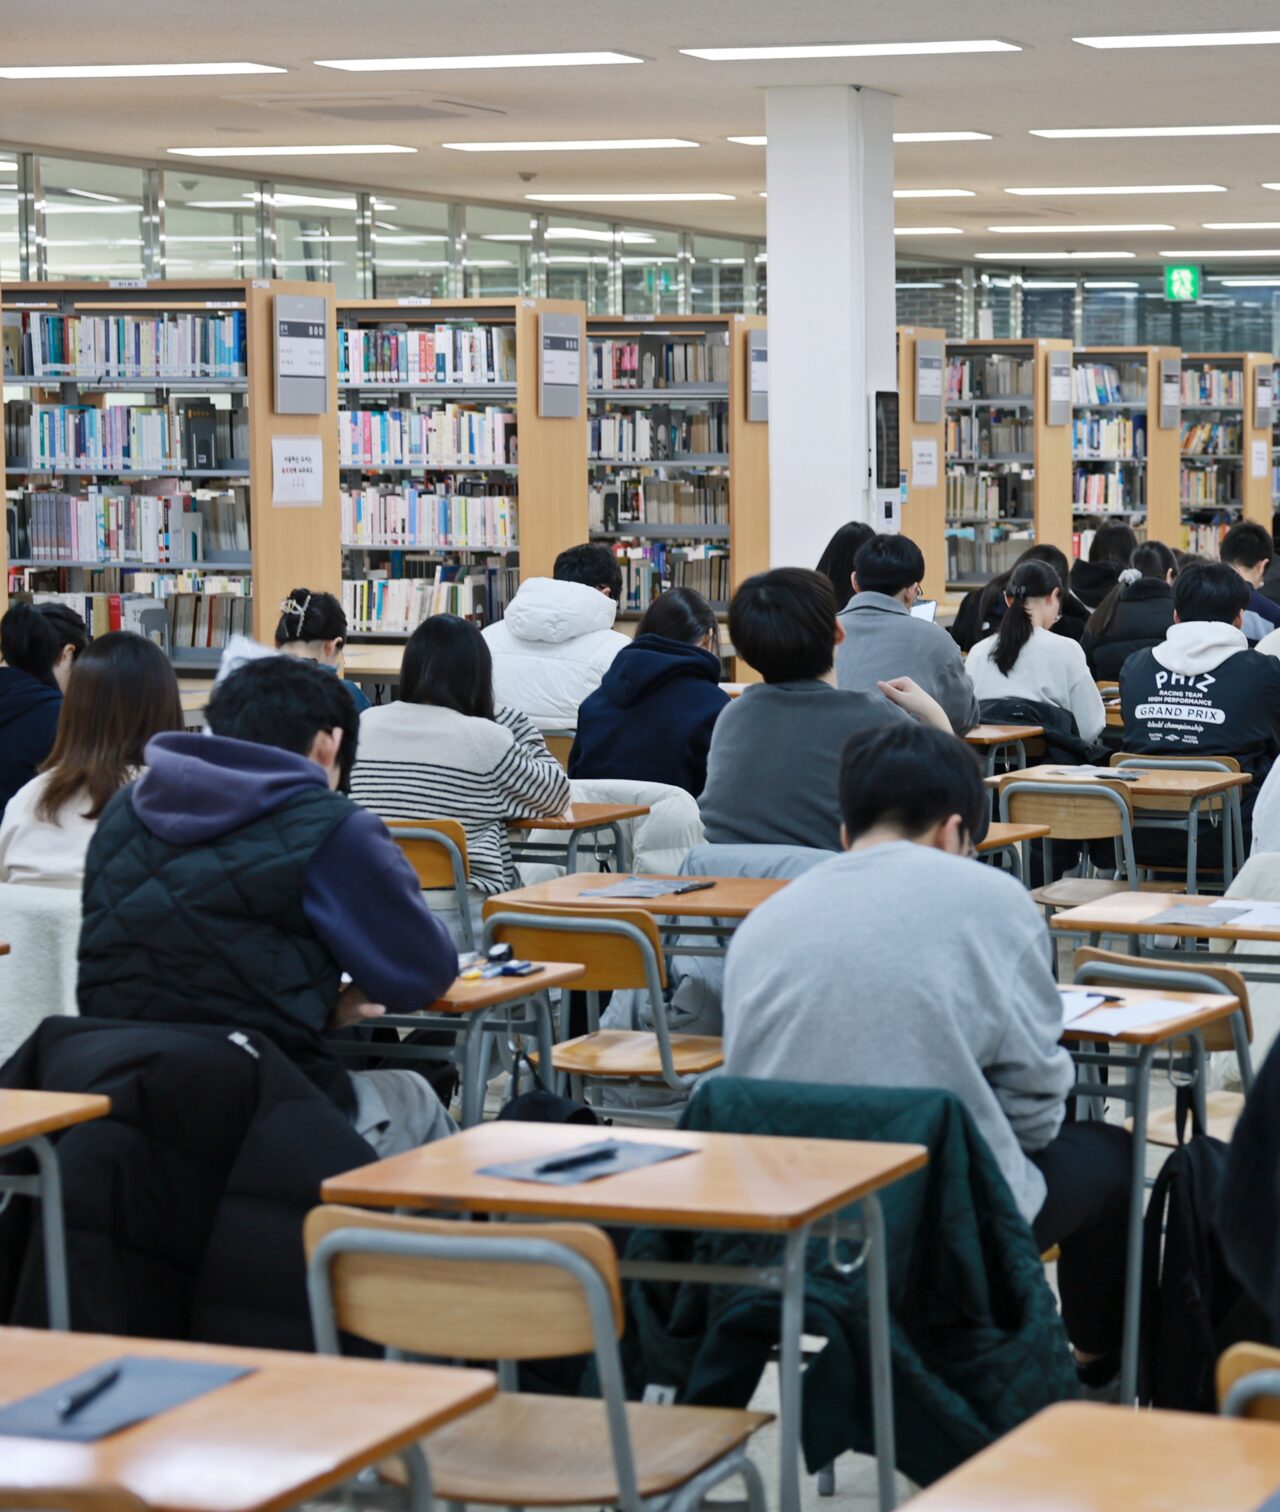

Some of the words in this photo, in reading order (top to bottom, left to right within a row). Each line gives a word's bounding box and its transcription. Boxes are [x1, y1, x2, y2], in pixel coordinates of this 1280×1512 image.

[308, 325, 324, 336] 800
[1185, 691, 1203, 699] TEAM
[1164, 697, 1212, 706] PERFORMANCE
[1140, 706, 1182, 717] GRAND
[1187, 708, 1217, 720] PRIX
